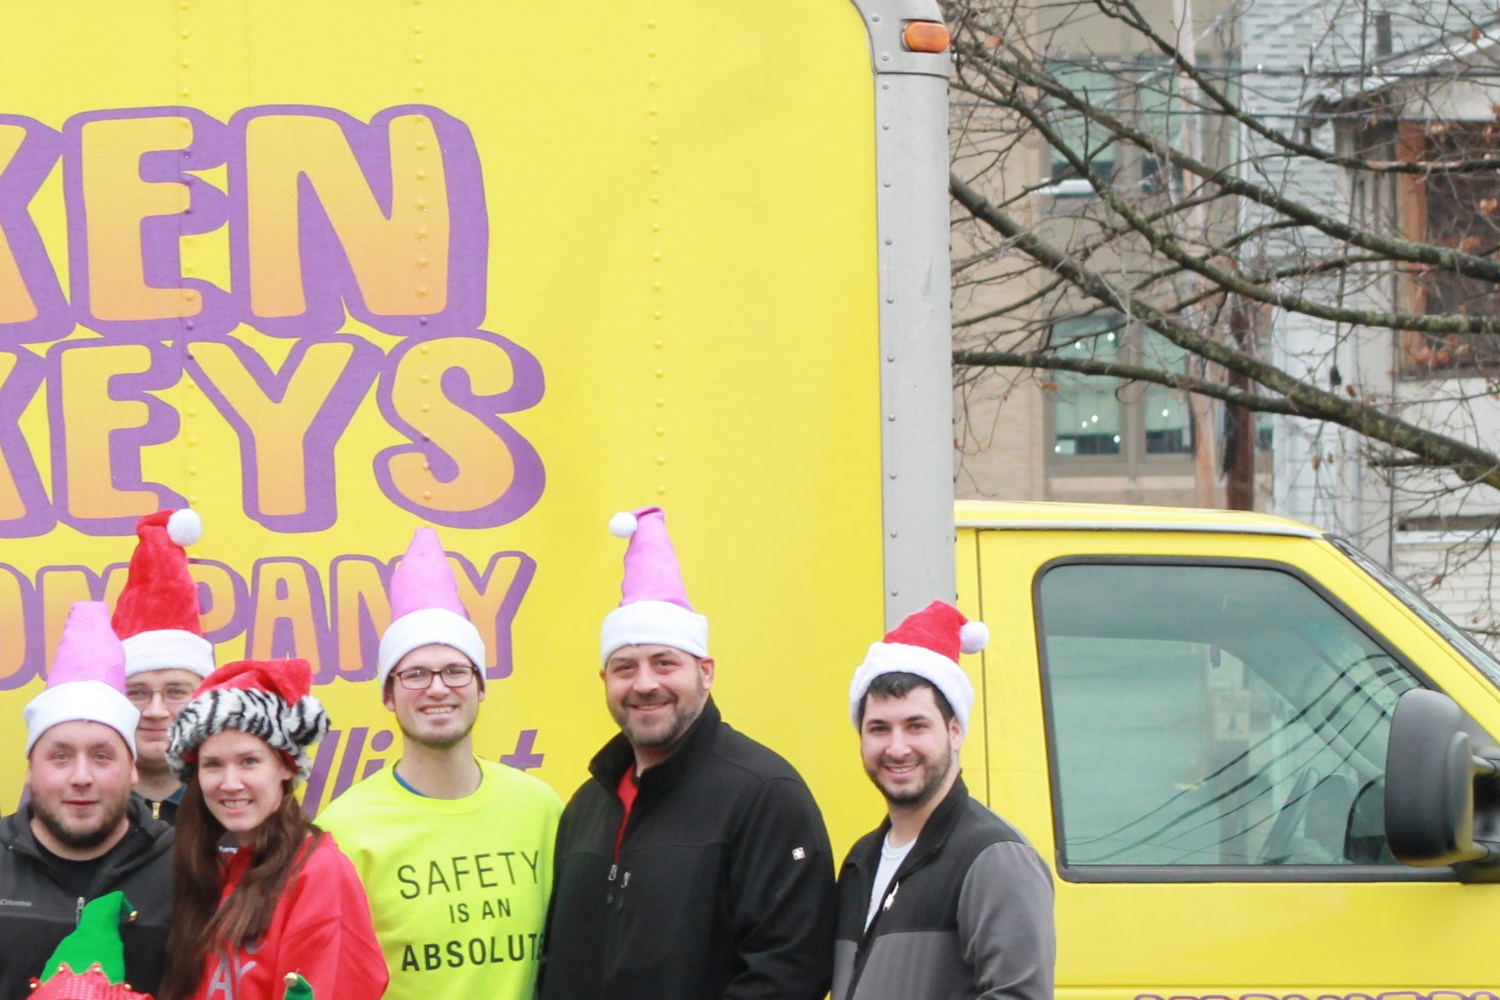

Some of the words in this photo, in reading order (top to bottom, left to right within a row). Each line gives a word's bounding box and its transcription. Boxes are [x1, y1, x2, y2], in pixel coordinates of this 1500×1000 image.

[396, 850, 540, 900] SAFETY
[449, 902, 470, 924] IS
[481, 897, 512, 921] AN
